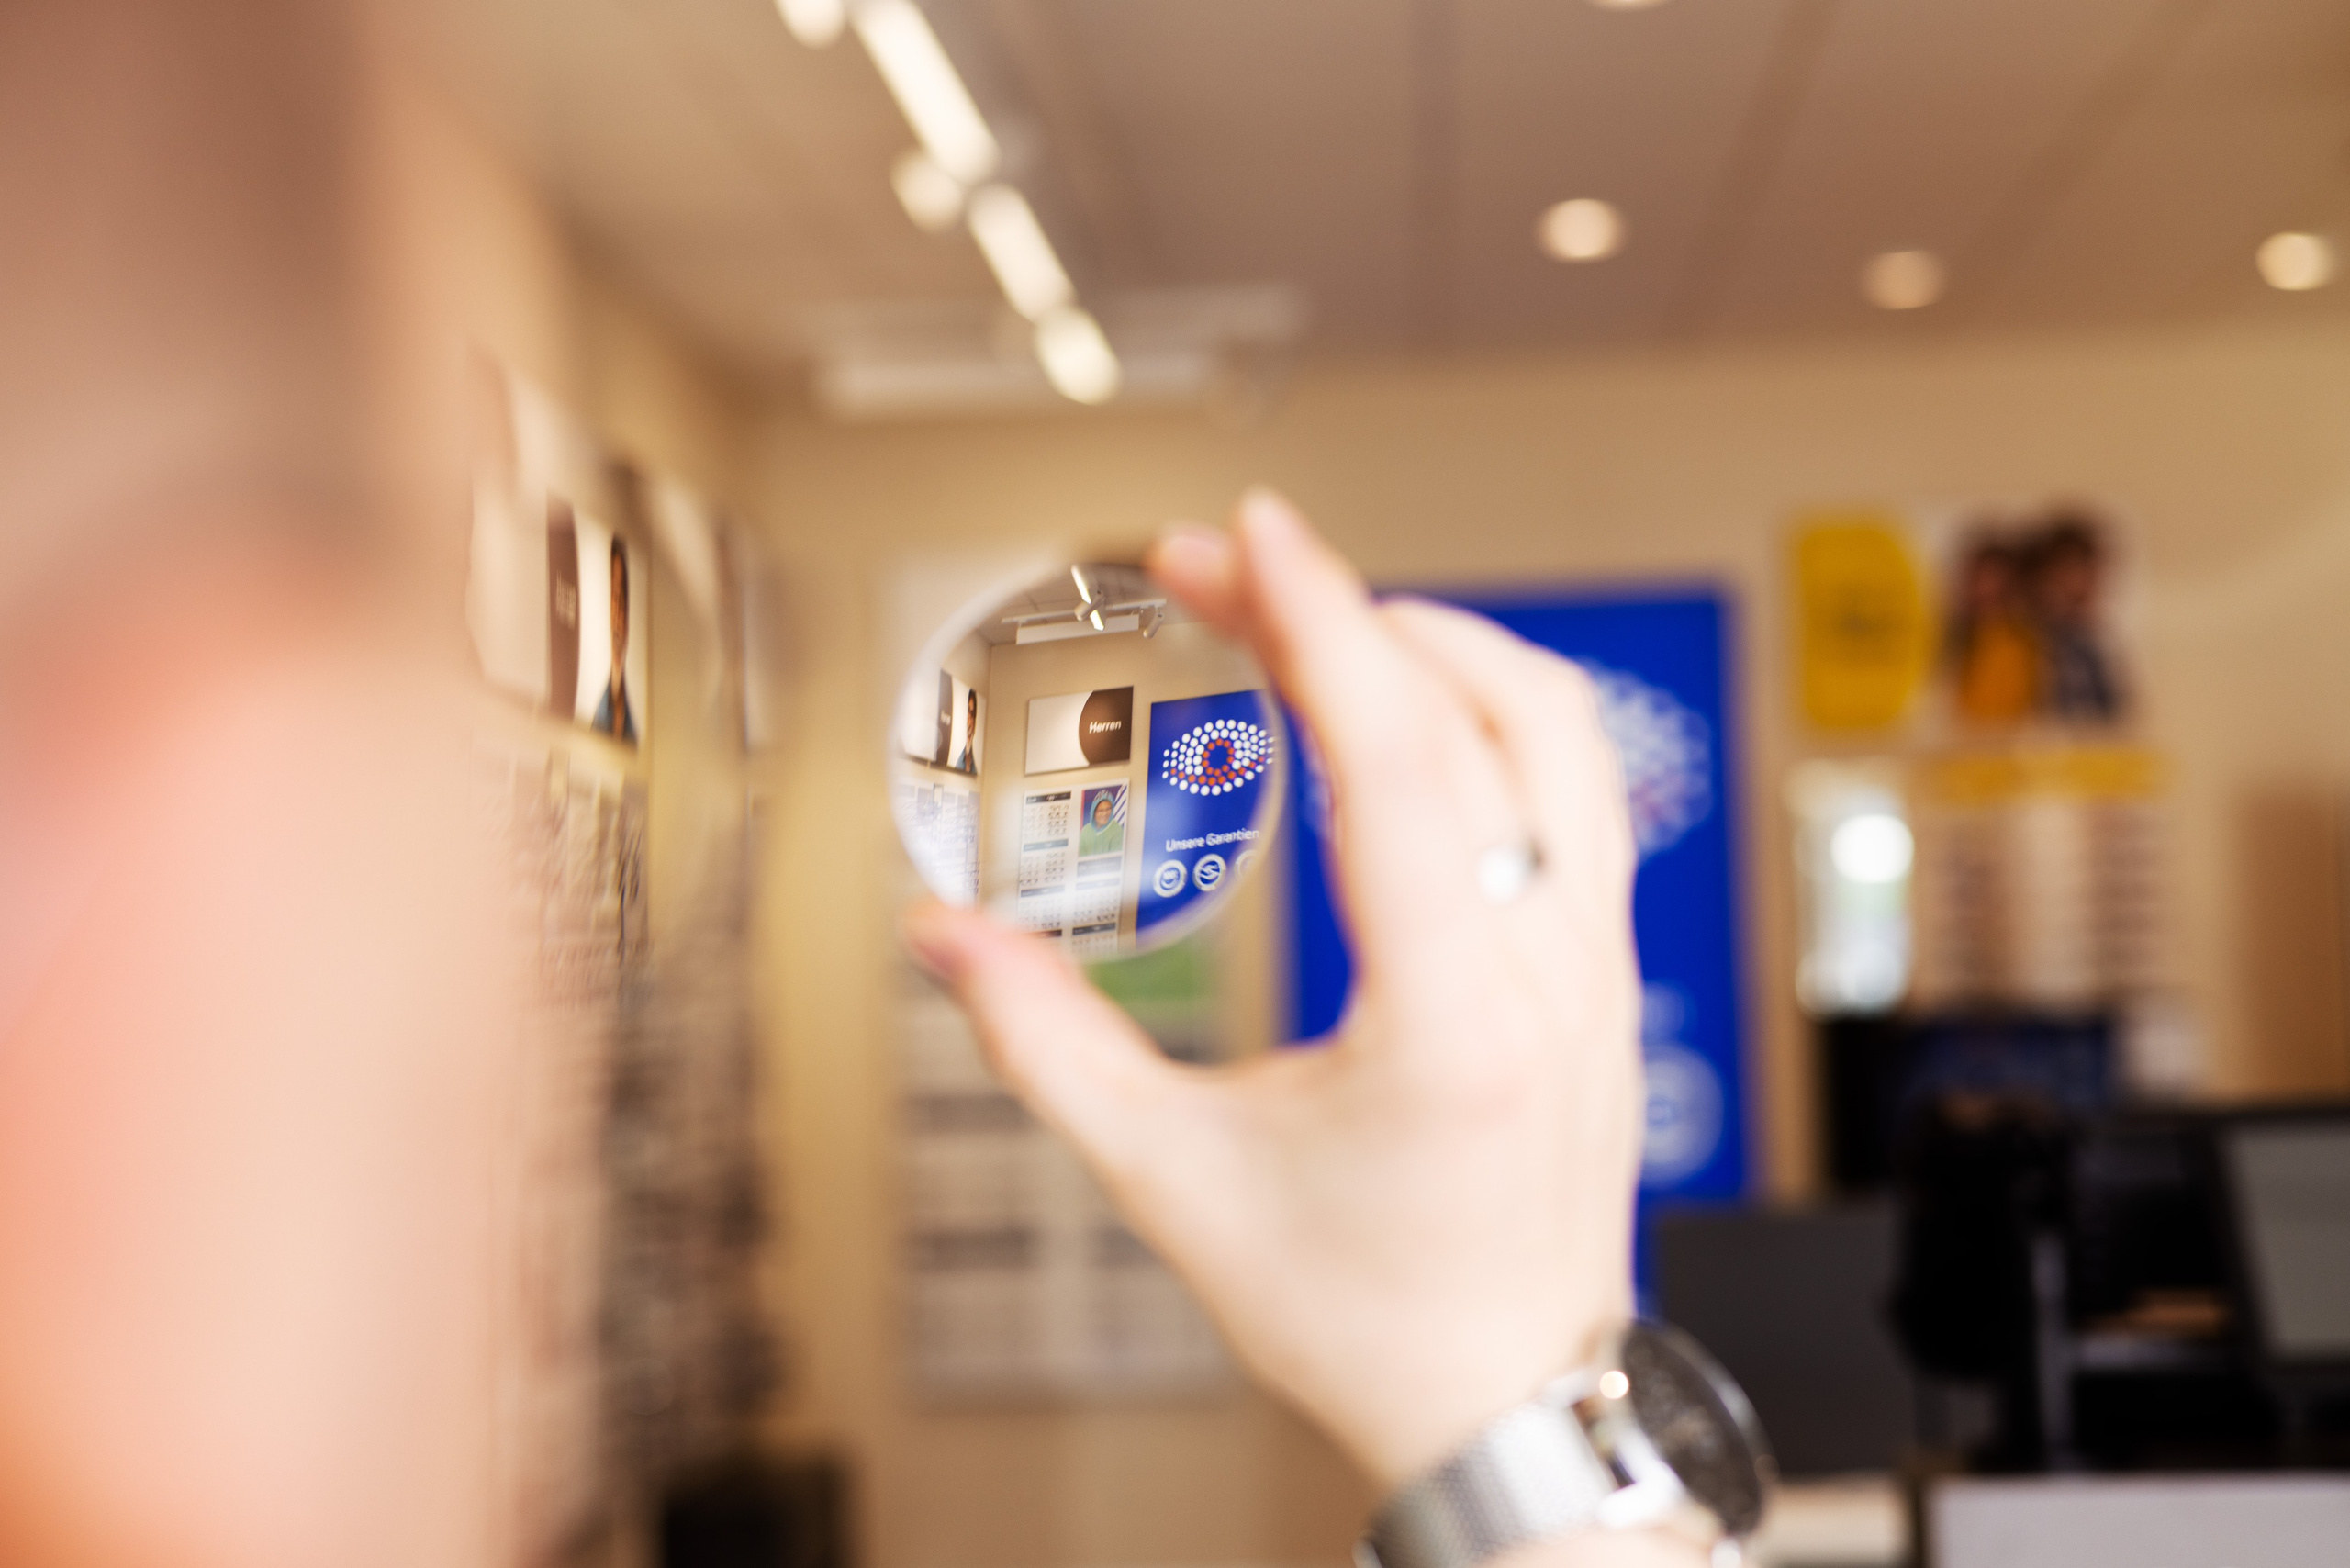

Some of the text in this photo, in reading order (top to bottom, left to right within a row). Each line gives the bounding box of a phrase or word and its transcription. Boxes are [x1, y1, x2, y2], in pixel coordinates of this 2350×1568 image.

[1089, 720, 1122, 734] Herren
[1166, 827, 1259, 853] Unsere Garantien
